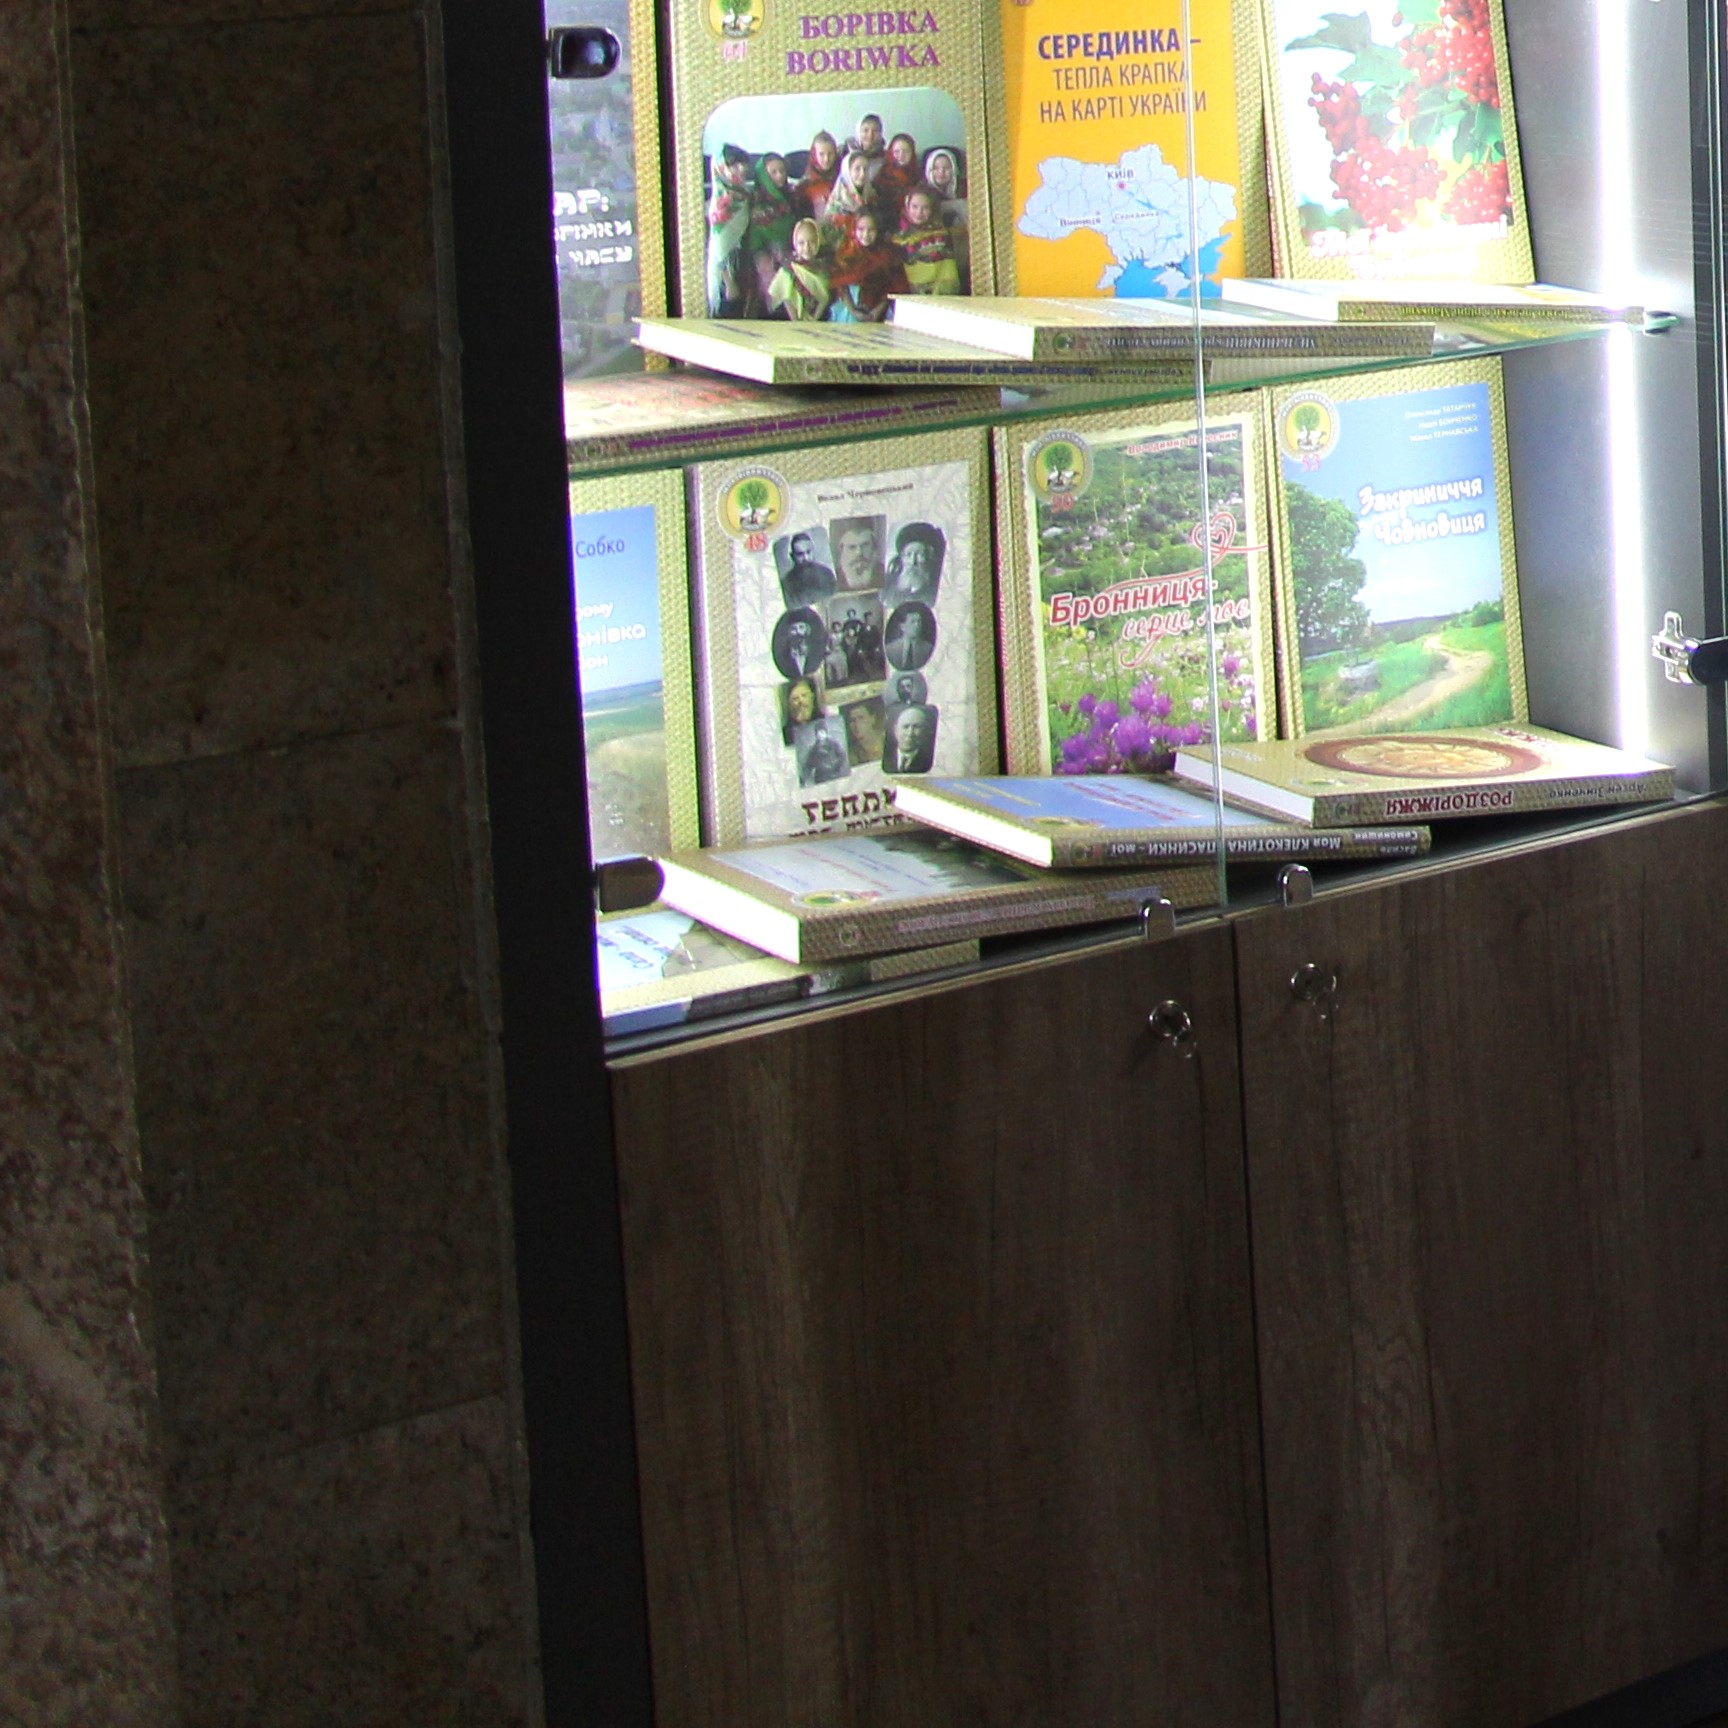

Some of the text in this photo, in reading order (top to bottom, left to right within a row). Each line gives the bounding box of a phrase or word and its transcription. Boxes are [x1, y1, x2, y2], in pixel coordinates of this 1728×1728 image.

[799, 9, 941, 40] БОРІВКА
[785, 43, 941, 76] BORIWKA
[1037, 27, 1181, 63] СЕРЕДИНКА
[1052, 59, 1190, 92] ТЕПЛА КРАПКА
[1039, 99, 1067, 124] НА
[1071, 95, 1124, 121] КАРТІ
[1358, 477, 1484, 517] Закриниччя
[575, 534, 626, 559] Собко
[801, 786, 898, 824] ТЕПЛИ
[1384, 789, 1513, 817] РОЗДОРІЖЖЯ
[1227, 836, 1310, 852] КЛЕКОТИНА
[1313, 837, 1341, 851] Моя
